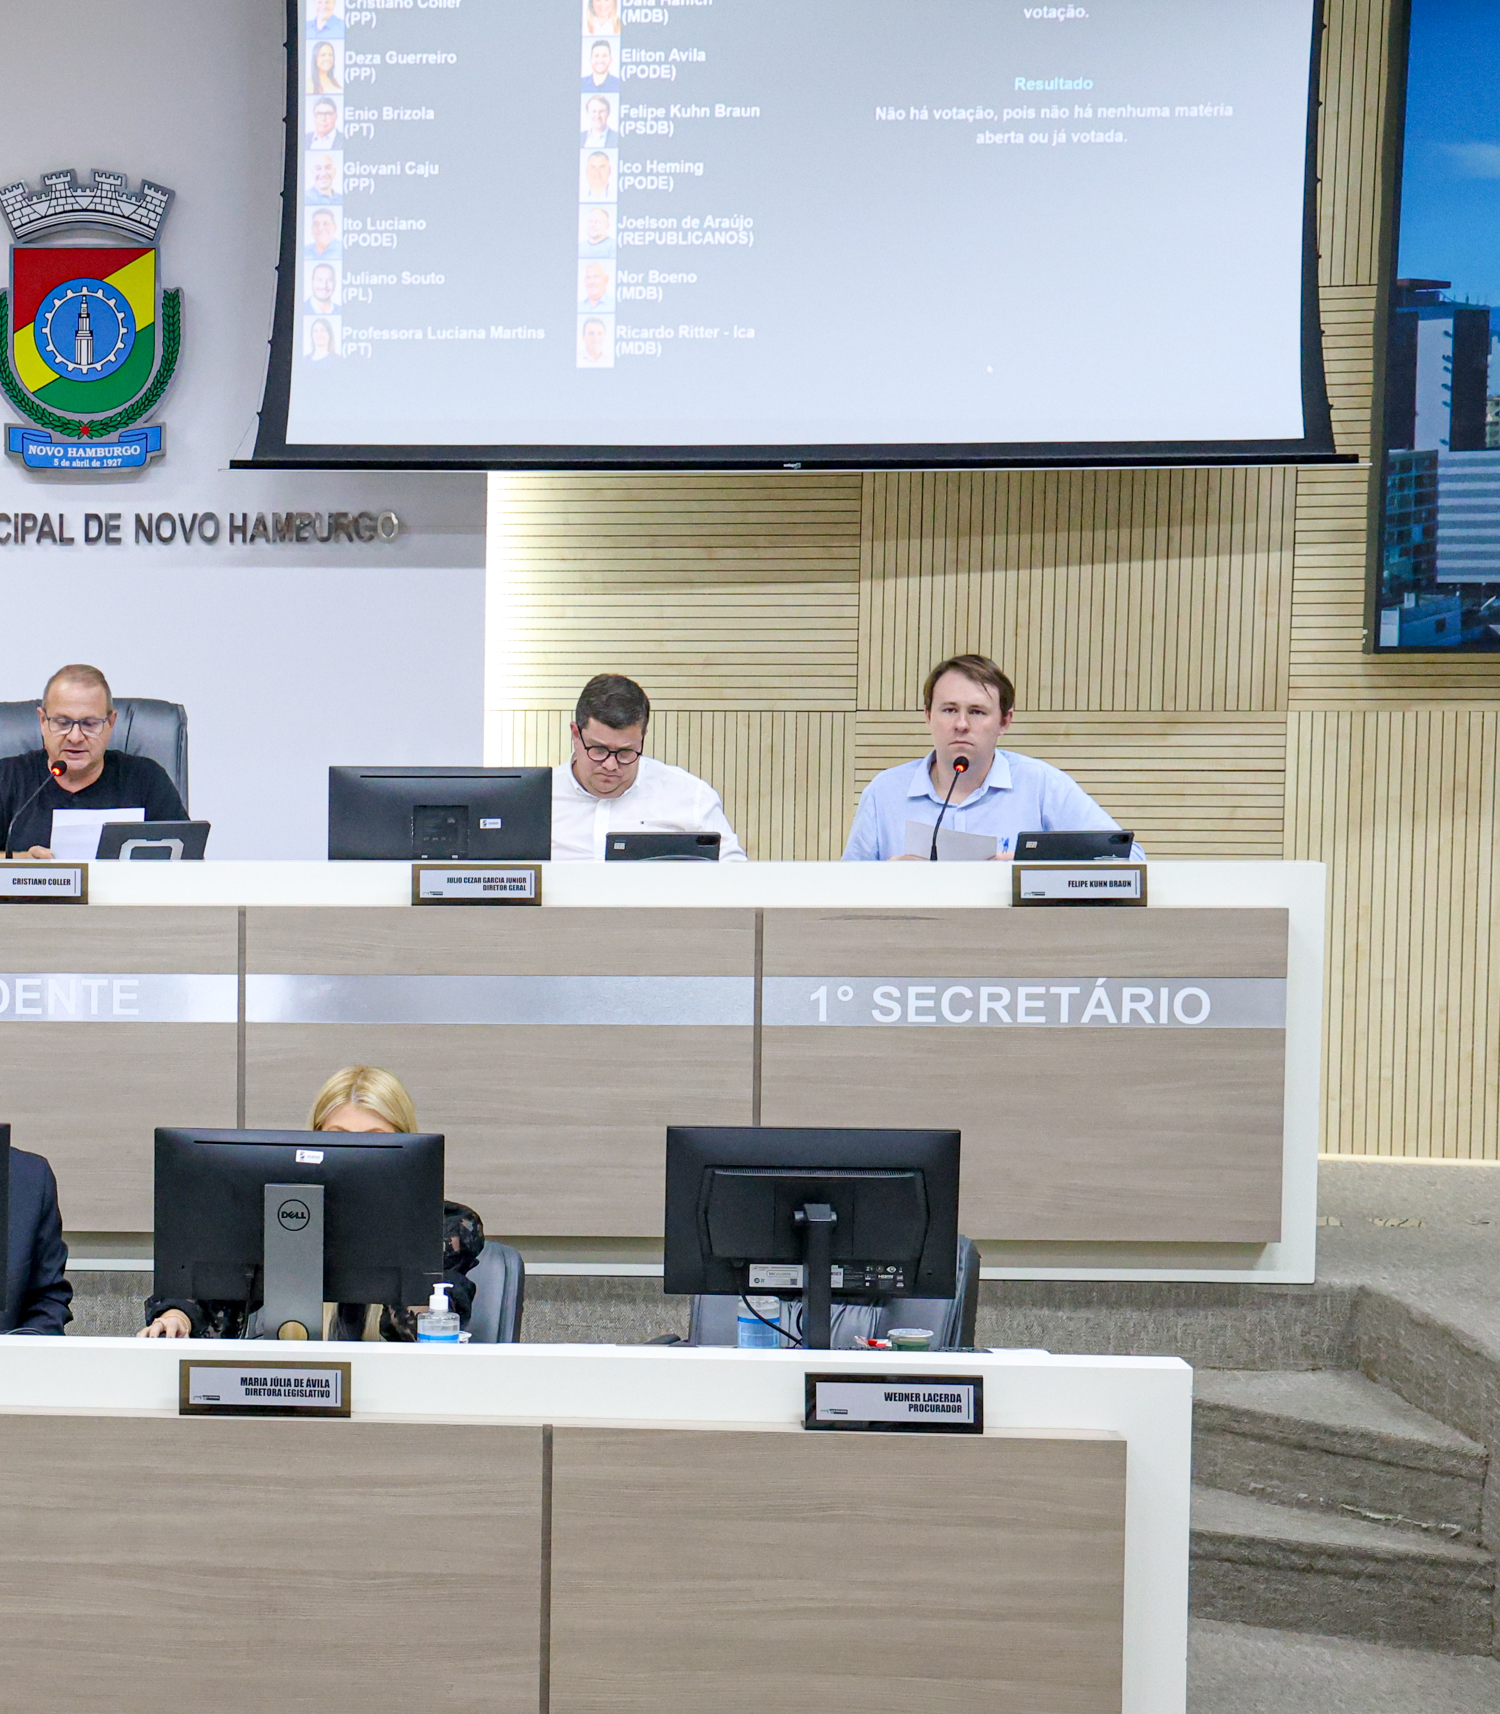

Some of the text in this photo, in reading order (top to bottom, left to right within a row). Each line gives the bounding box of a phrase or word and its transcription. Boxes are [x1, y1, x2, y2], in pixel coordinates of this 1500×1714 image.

[346, 0, 462, 8] Cristiano Coller
[346, 12, 377, 28] (PP)
[622, 9, 669, 25] (MDB)
[1023, 4, 1090, 22] votação.
[346, 51, 457, 64] Deza Guerreiro
[622, 48, 706, 62] Eliton Avila
[346, 67, 376, 84] (PP)
[621, 65, 677, 81] (PODE)
[1014, 77, 1094, 90] Resultado
[346, 107, 435, 120] Enio Brizola
[620, 104, 761, 121] Felipe Kuhn Braun
[875, 102, 1234, 122] Não há votação, pois não há nenhuma matéria
[344, 122, 375, 139] (PT)
[620, 121, 675, 137] (PSDB)
[975, 129, 1128, 146] aberta ou já votada.
[344, 161, 439, 177] Giovani Caju
[620, 160, 704, 176] Ico Heming
[343, 177, 375, 195] (PP)
[619, 176, 674, 192] (PODE)
[343, 217, 427, 231] Ito Luciano
[618, 214, 754, 231] Joelson de Araújo
[343, 233, 398, 249] (PODE)
[618, 231, 755, 247] (REPUBLICANOS)
[343, 271, 446, 284] Juliano Souto
[617, 270, 698, 283] Nor Boeno
[342, 287, 373, 304] (PL)
[617, 286, 663, 302] (MDB)
[342, 325, 546, 339] Professora Luciana Martins
[615, 325, 675, 338] Ricardo
[678, 325, 721, 338] Ritter
[733, 325, 756, 338] Ica
[342, 342, 373, 358] (PT)
[614, 341, 662, 357] (MDB)
[28, 445, 141, 457] NOVO HAMBURGO
[53, 458, 122, 467] 5 de abril de 1927
[84, 512, 122, 546] DE
[134, 511, 221, 546] NOVO
[229, 511, 400, 545] HAMBURGO
[12, 877, 71, 886] CRISTIANO COLLER
[446, 876, 527, 884] JULIO CEZAR GARCIA JUNIOR
[482, 884, 527, 892] DIRETOR GERAL
[1067, 880, 1132, 888] FELIPE KUHN BRAUN
[809, 977, 1211, 1025] 1° SECRETÁRIO
[281, 1210, 307, 1220] DELL
[240, 1376, 331, 1389] MARIA JÚLIA DE ÁVILA
[244, 1387, 331, 1398] DIRETORA LEGISLATIVO
[884, 1391, 962, 1403] WEDNER LACERDA
[908, 1403, 963, 1413] PROCURADOR
